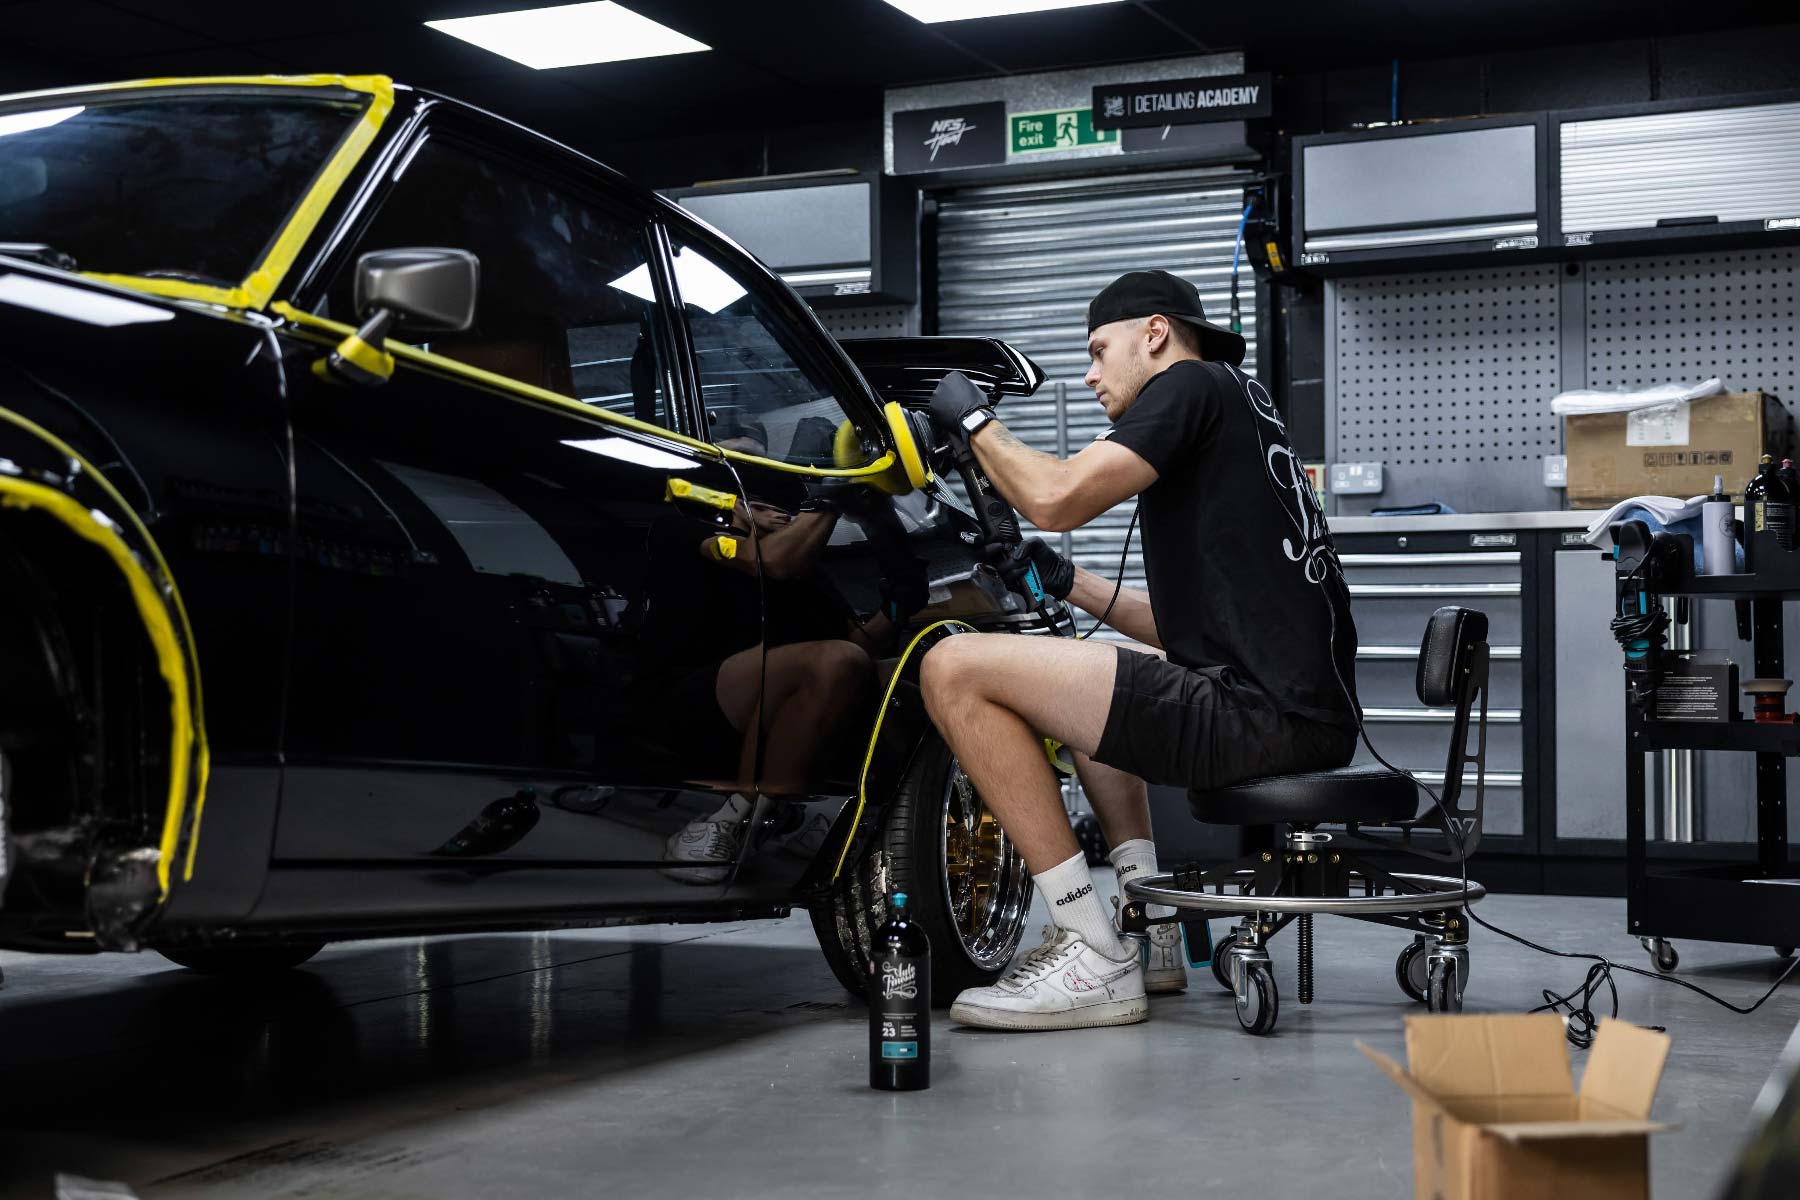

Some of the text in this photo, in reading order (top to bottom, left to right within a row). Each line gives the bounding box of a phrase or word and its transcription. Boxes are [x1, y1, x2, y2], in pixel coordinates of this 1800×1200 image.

[1135, 91, 1195, 113] DETAILING
[1197, 86, 1259, 108] ACADEMY
[931, 118, 964, 132] NFS
[1018, 120, 1043, 132] Fire
[1018, 133, 1044, 146] exit
[1056, 883, 1093, 906] adidas
[882, 1028, 896, 1037] 23
